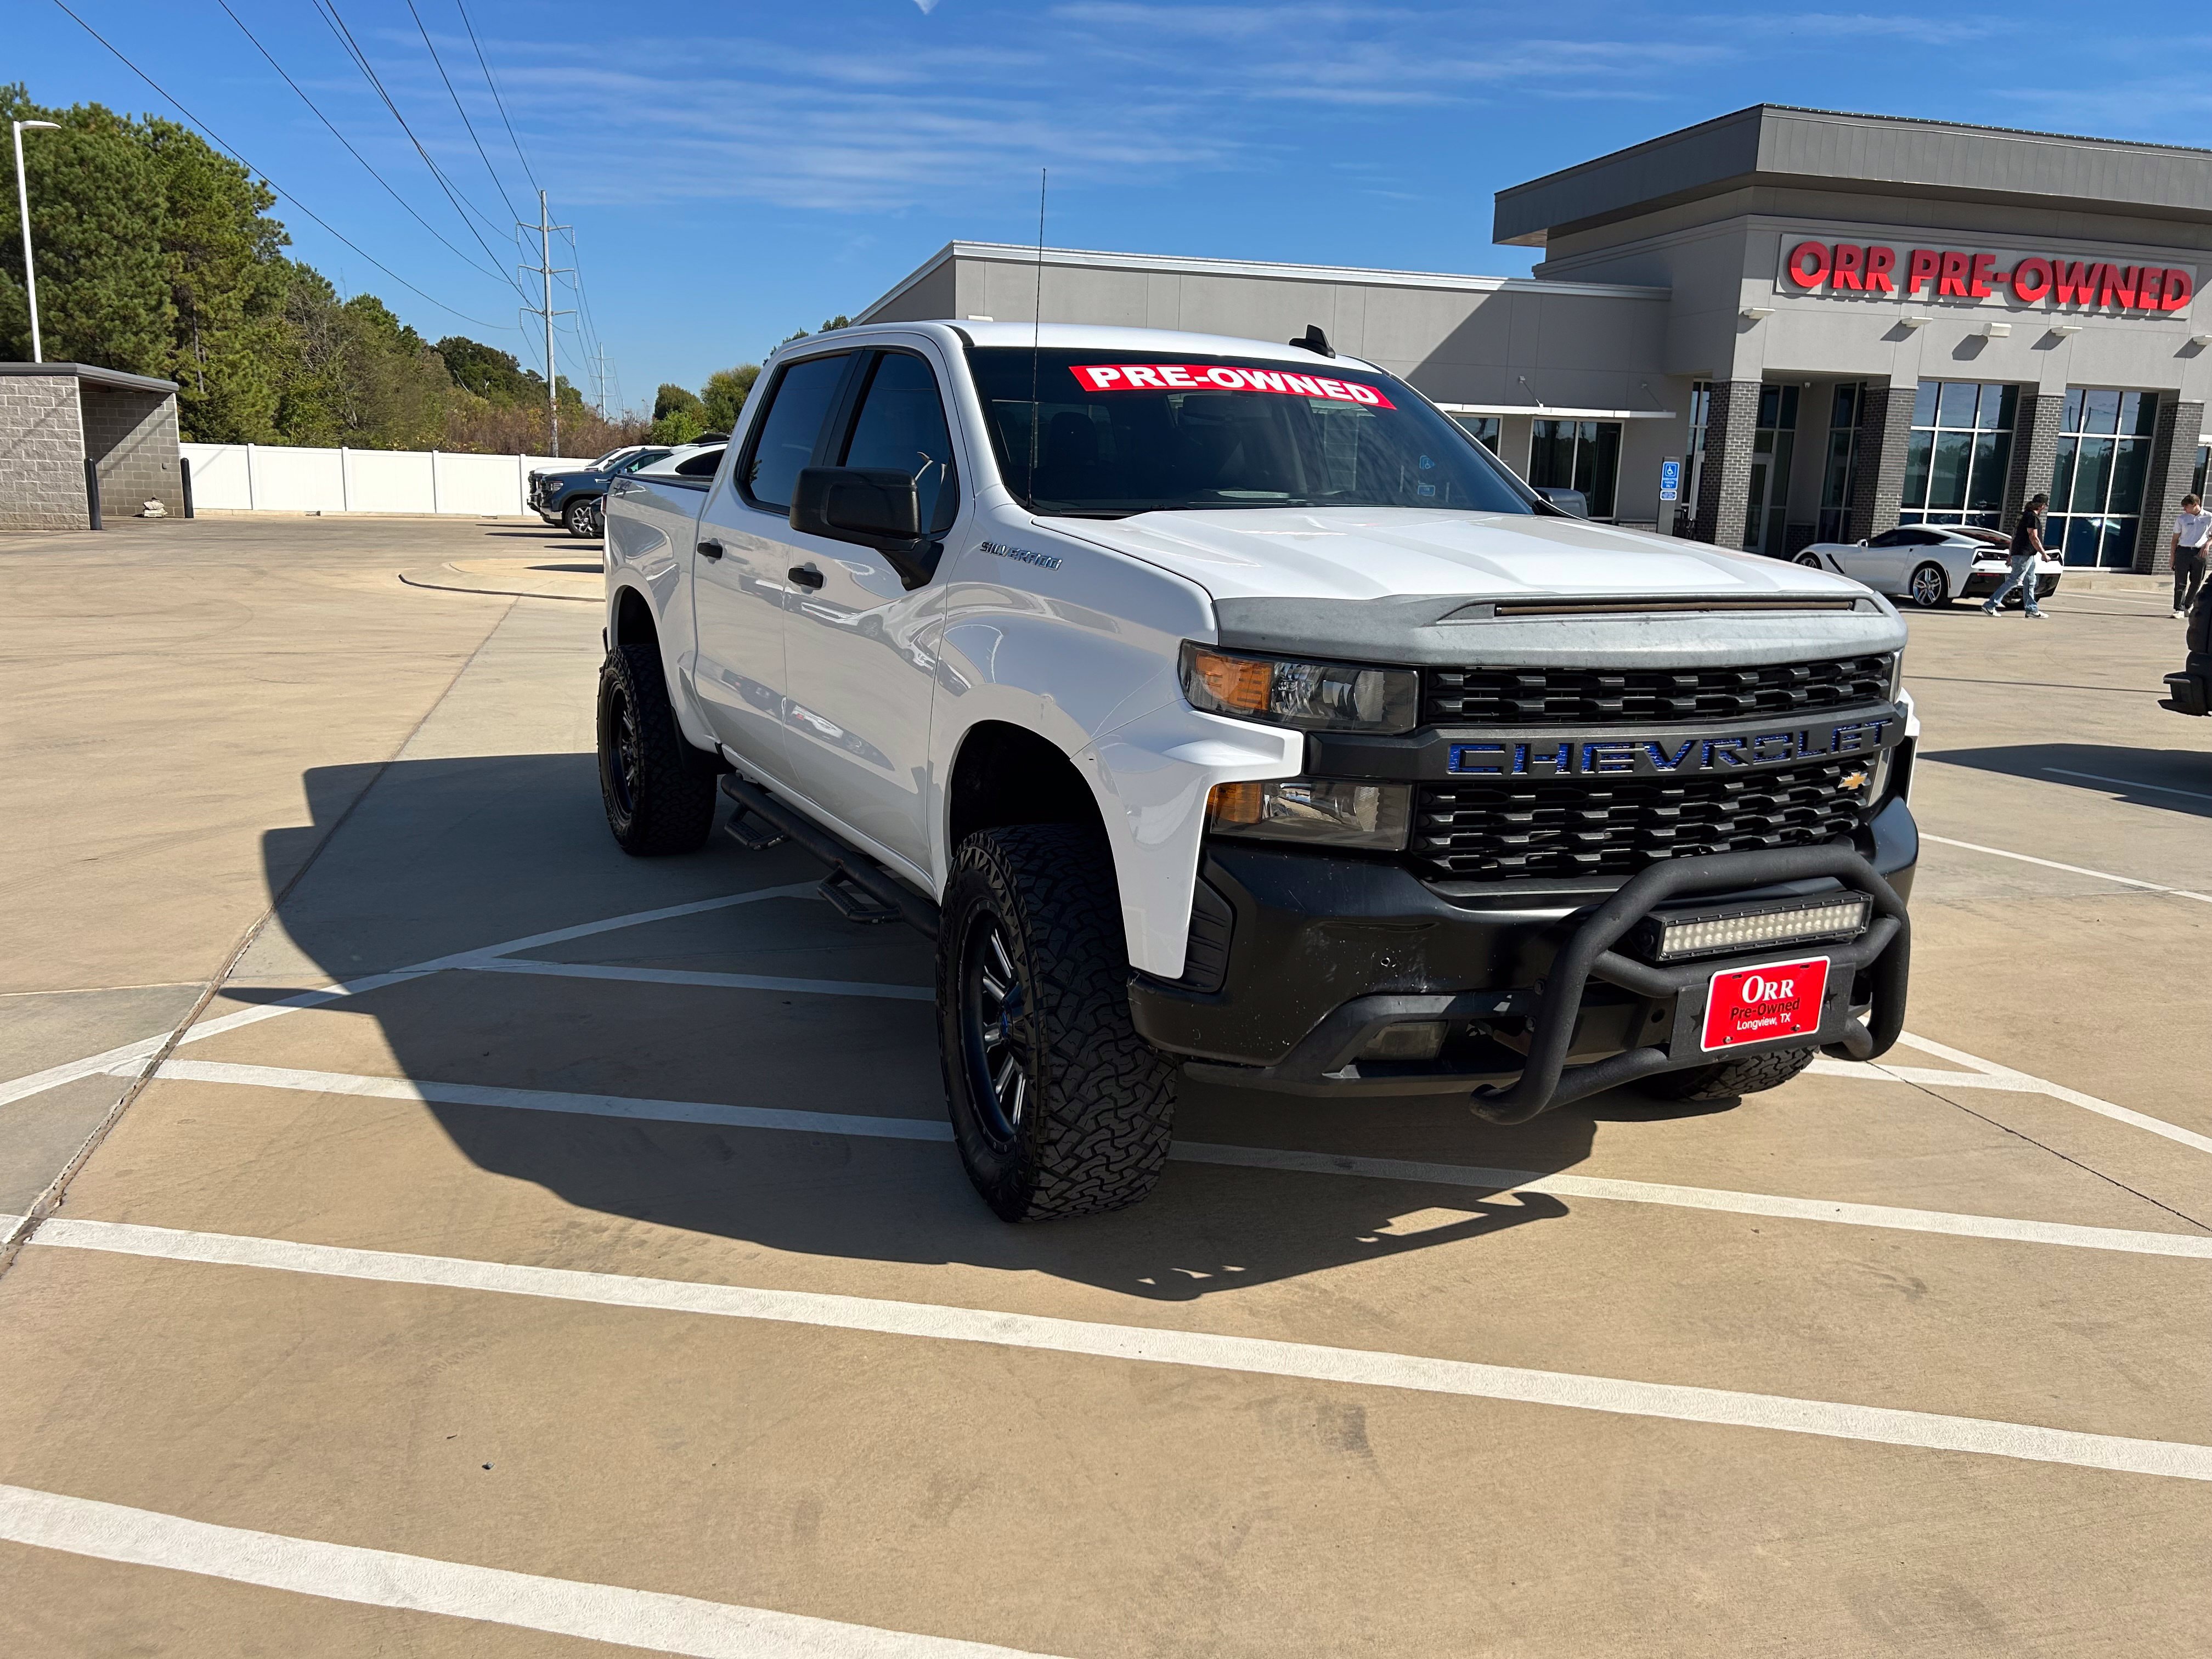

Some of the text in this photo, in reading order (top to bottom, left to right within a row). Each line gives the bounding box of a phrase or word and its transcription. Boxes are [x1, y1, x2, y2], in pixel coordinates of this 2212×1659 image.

[1790, 241, 2192, 310] ORR PRE-OWNED
[1086, 366, 1379, 404] PRE-OWNED
[979, 541, 1063, 571] SILVERADO
[1446, 718, 1893, 775] CHEVROLET
[1742, 975, 1794, 1003] ORR
[1730, 997, 1801, 1020] Pre-Owned
[1780, 1013, 1791, 1024] TX
